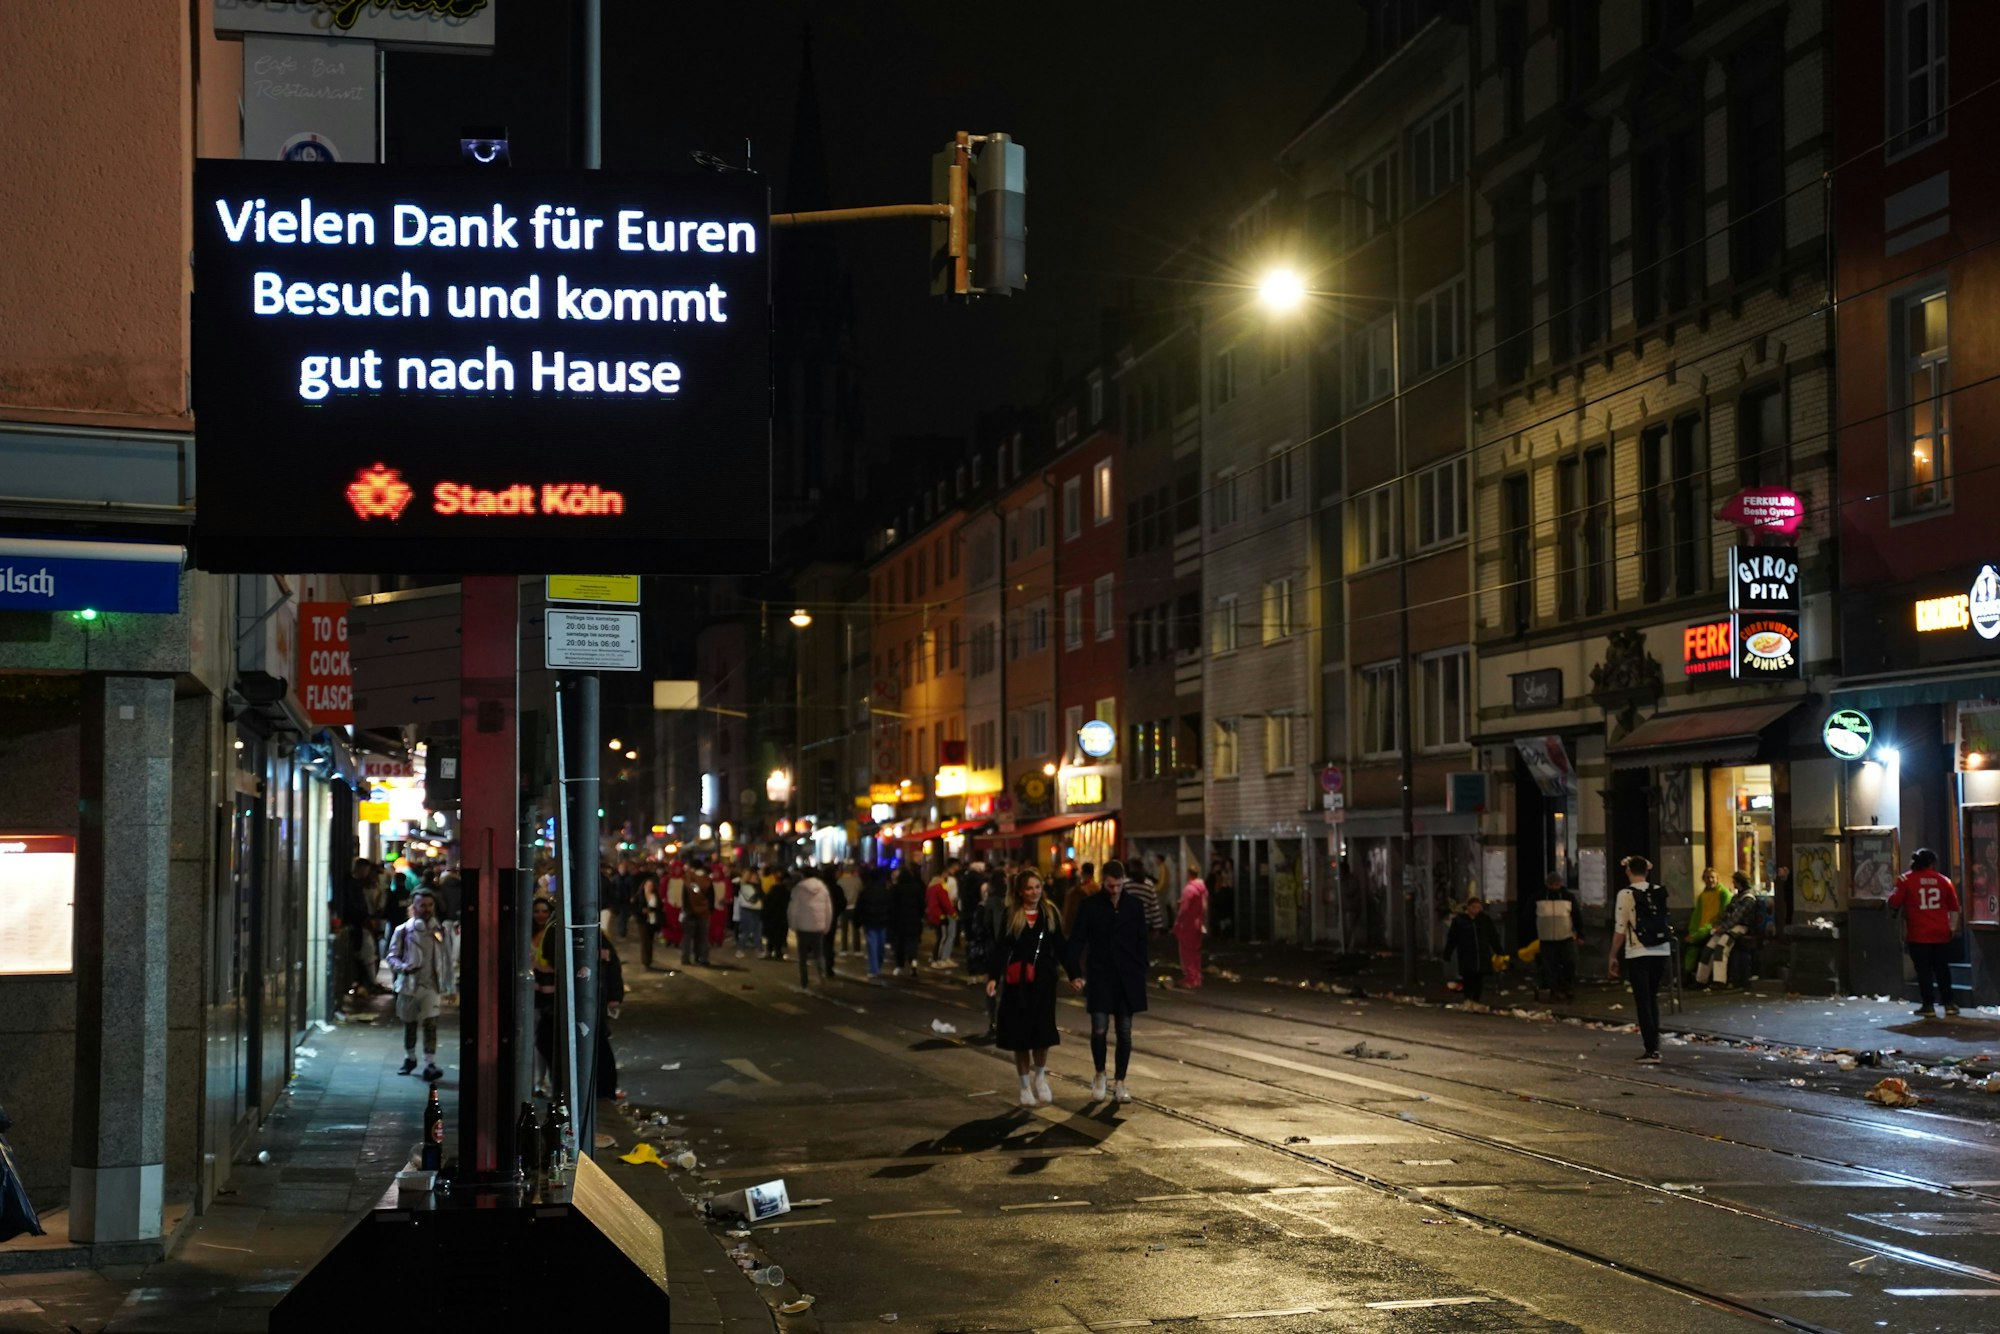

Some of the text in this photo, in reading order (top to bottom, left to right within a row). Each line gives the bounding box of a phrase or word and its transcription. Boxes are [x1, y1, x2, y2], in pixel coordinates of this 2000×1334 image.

[311, 58, 346, 77] Bar
[253, 79, 365, 101] Restaurant
[216, 198, 756, 254] Vielen Dank für Euren
[254, 271, 728, 322] Besuch und kommt
[299, 346, 682, 401] gut nach Hause
[433, 482, 625, 516] Stadt Köln
[1743, 507, 1796, 518] Beste Gyros
[1755, 517, 1763, 526] in
[1738, 555, 1798, 585] GYROS
[1749, 582, 1790, 600] PITA
[312, 616, 348, 641] TO G
[566, 622, 620, 632] 20:00 bis 06:00
[1740, 620, 1799, 642] CURRYWURST
[566, 639, 620, 648] 20:00 bis 06:00
[1683, 622, 1730, 662] FERK
[310, 650, 352, 676] COCK
[1684, 662, 1707, 675] GYROS
[1743, 652, 1795, 671] POMMES
[306, 685, 354, 710] FLASCH
[365, 763, 414, 776] KIOSK
[1918, 888, 1940, 910] 12
